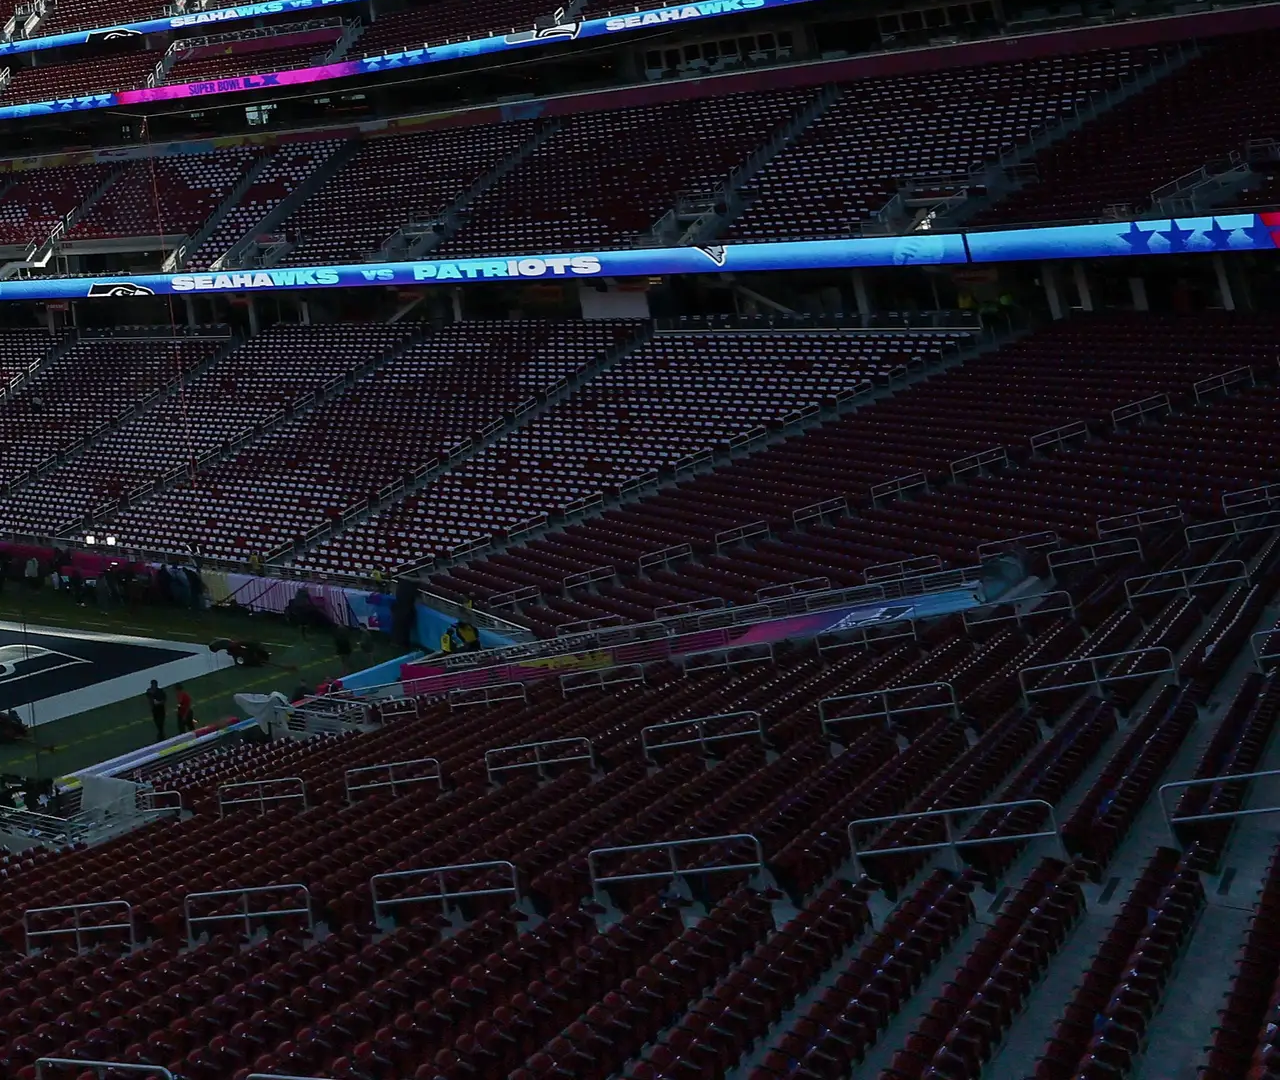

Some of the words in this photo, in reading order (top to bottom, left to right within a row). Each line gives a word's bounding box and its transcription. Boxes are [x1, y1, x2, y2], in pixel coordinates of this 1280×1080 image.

[170, 1, 284, 28] SEAHAWKS
[188, 82, 217, 95] SUPER
[217, 78, 242, 91] BOWL
[244, 74, 280, 88] LX
[171, 268, 339, 291] SEAHAWKS
[361, 269, 395, 281] VS
[414, 256, 602, 281] PATRIOTS
